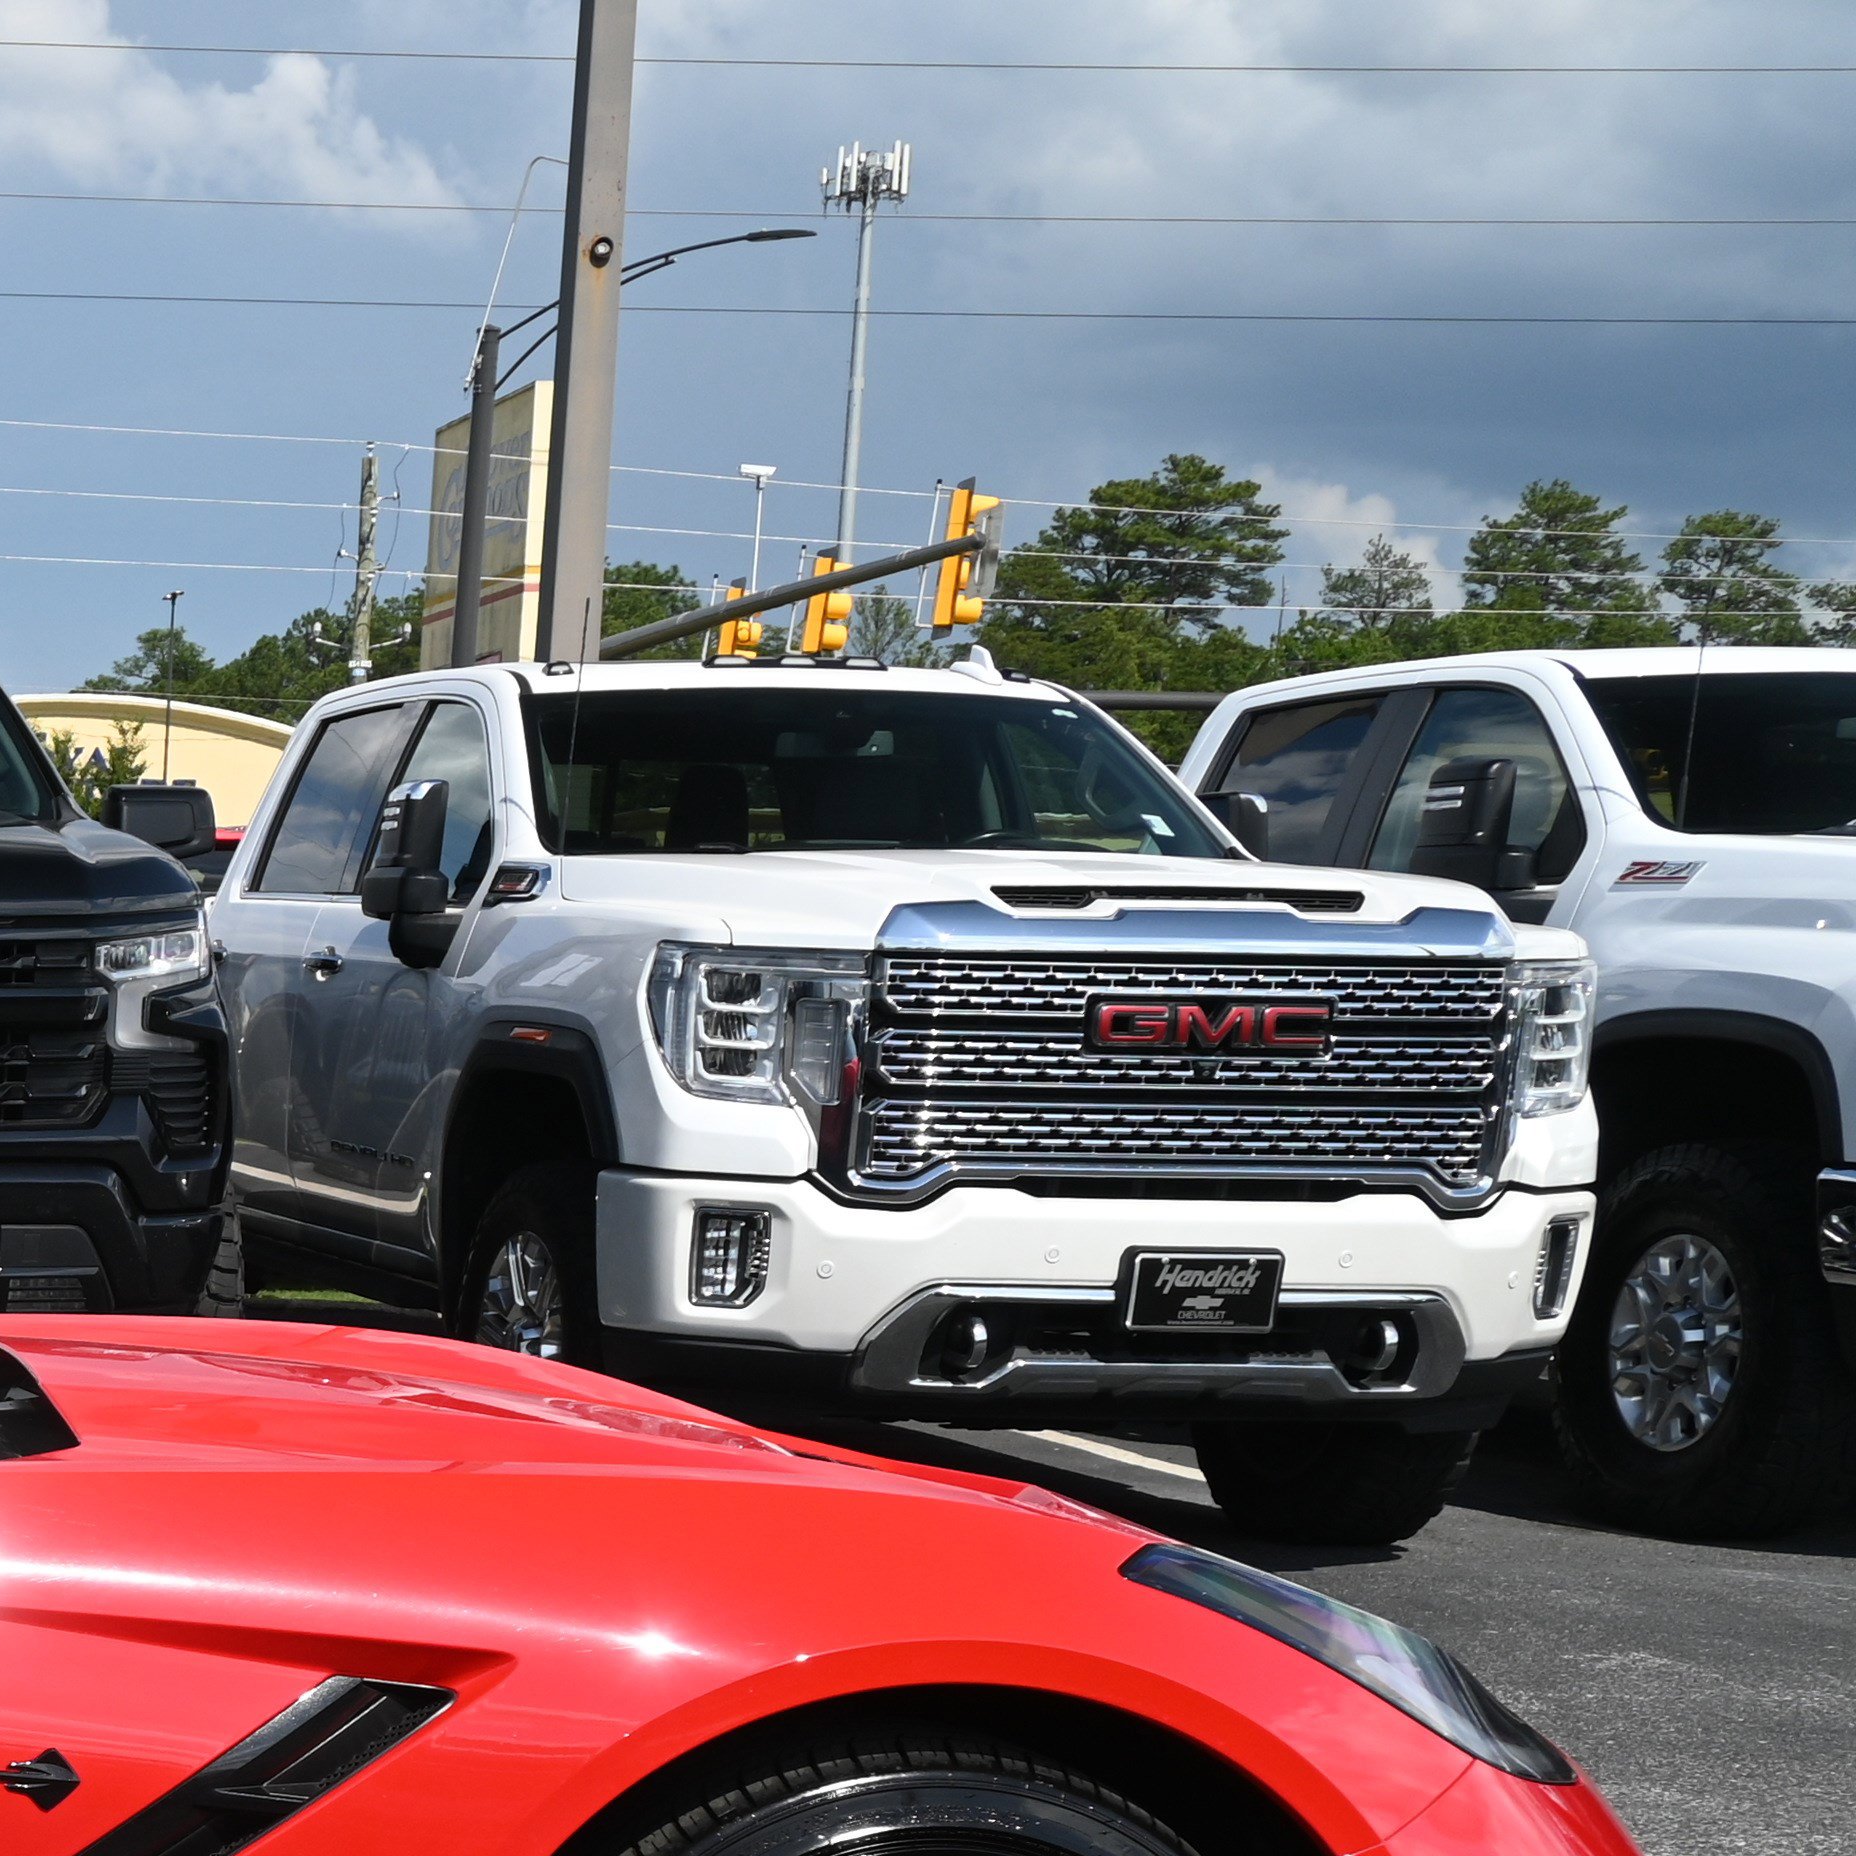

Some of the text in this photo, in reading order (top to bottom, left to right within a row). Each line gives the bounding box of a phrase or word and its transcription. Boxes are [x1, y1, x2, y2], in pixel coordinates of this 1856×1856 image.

[1098, 1004, 1330, 1048] GMC
[1154, 1263, 1261, 1295] Hendrick
[1177, 1310, 1226, 1319] CHEVROLET
